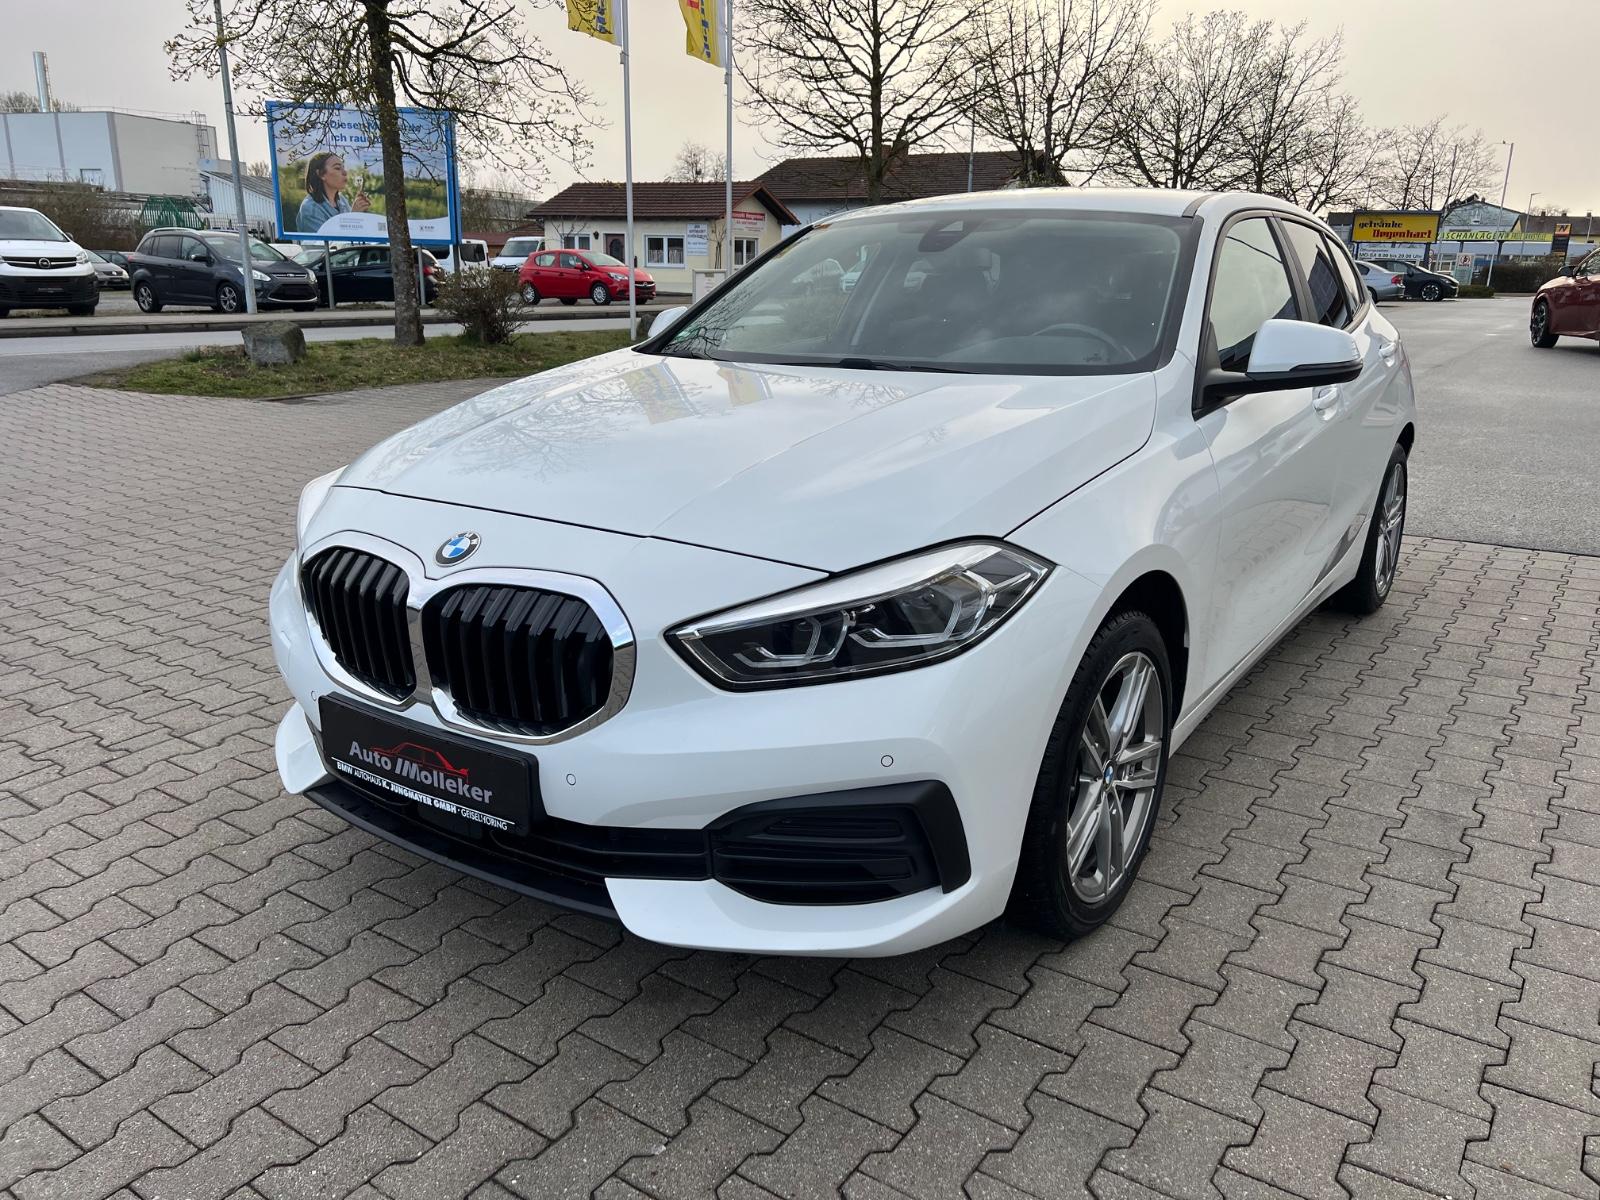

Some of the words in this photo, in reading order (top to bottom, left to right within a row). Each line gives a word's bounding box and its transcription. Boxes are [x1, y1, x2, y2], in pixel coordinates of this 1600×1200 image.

[349, 741, 392, 771] Auto
[336, 761, 353, 775] BMW
[354, 769, 382, 787] AUTOHAUS
[390, 783, 433, 806] JUNGMAYER
[433, 799, 457, 814] GMBH
